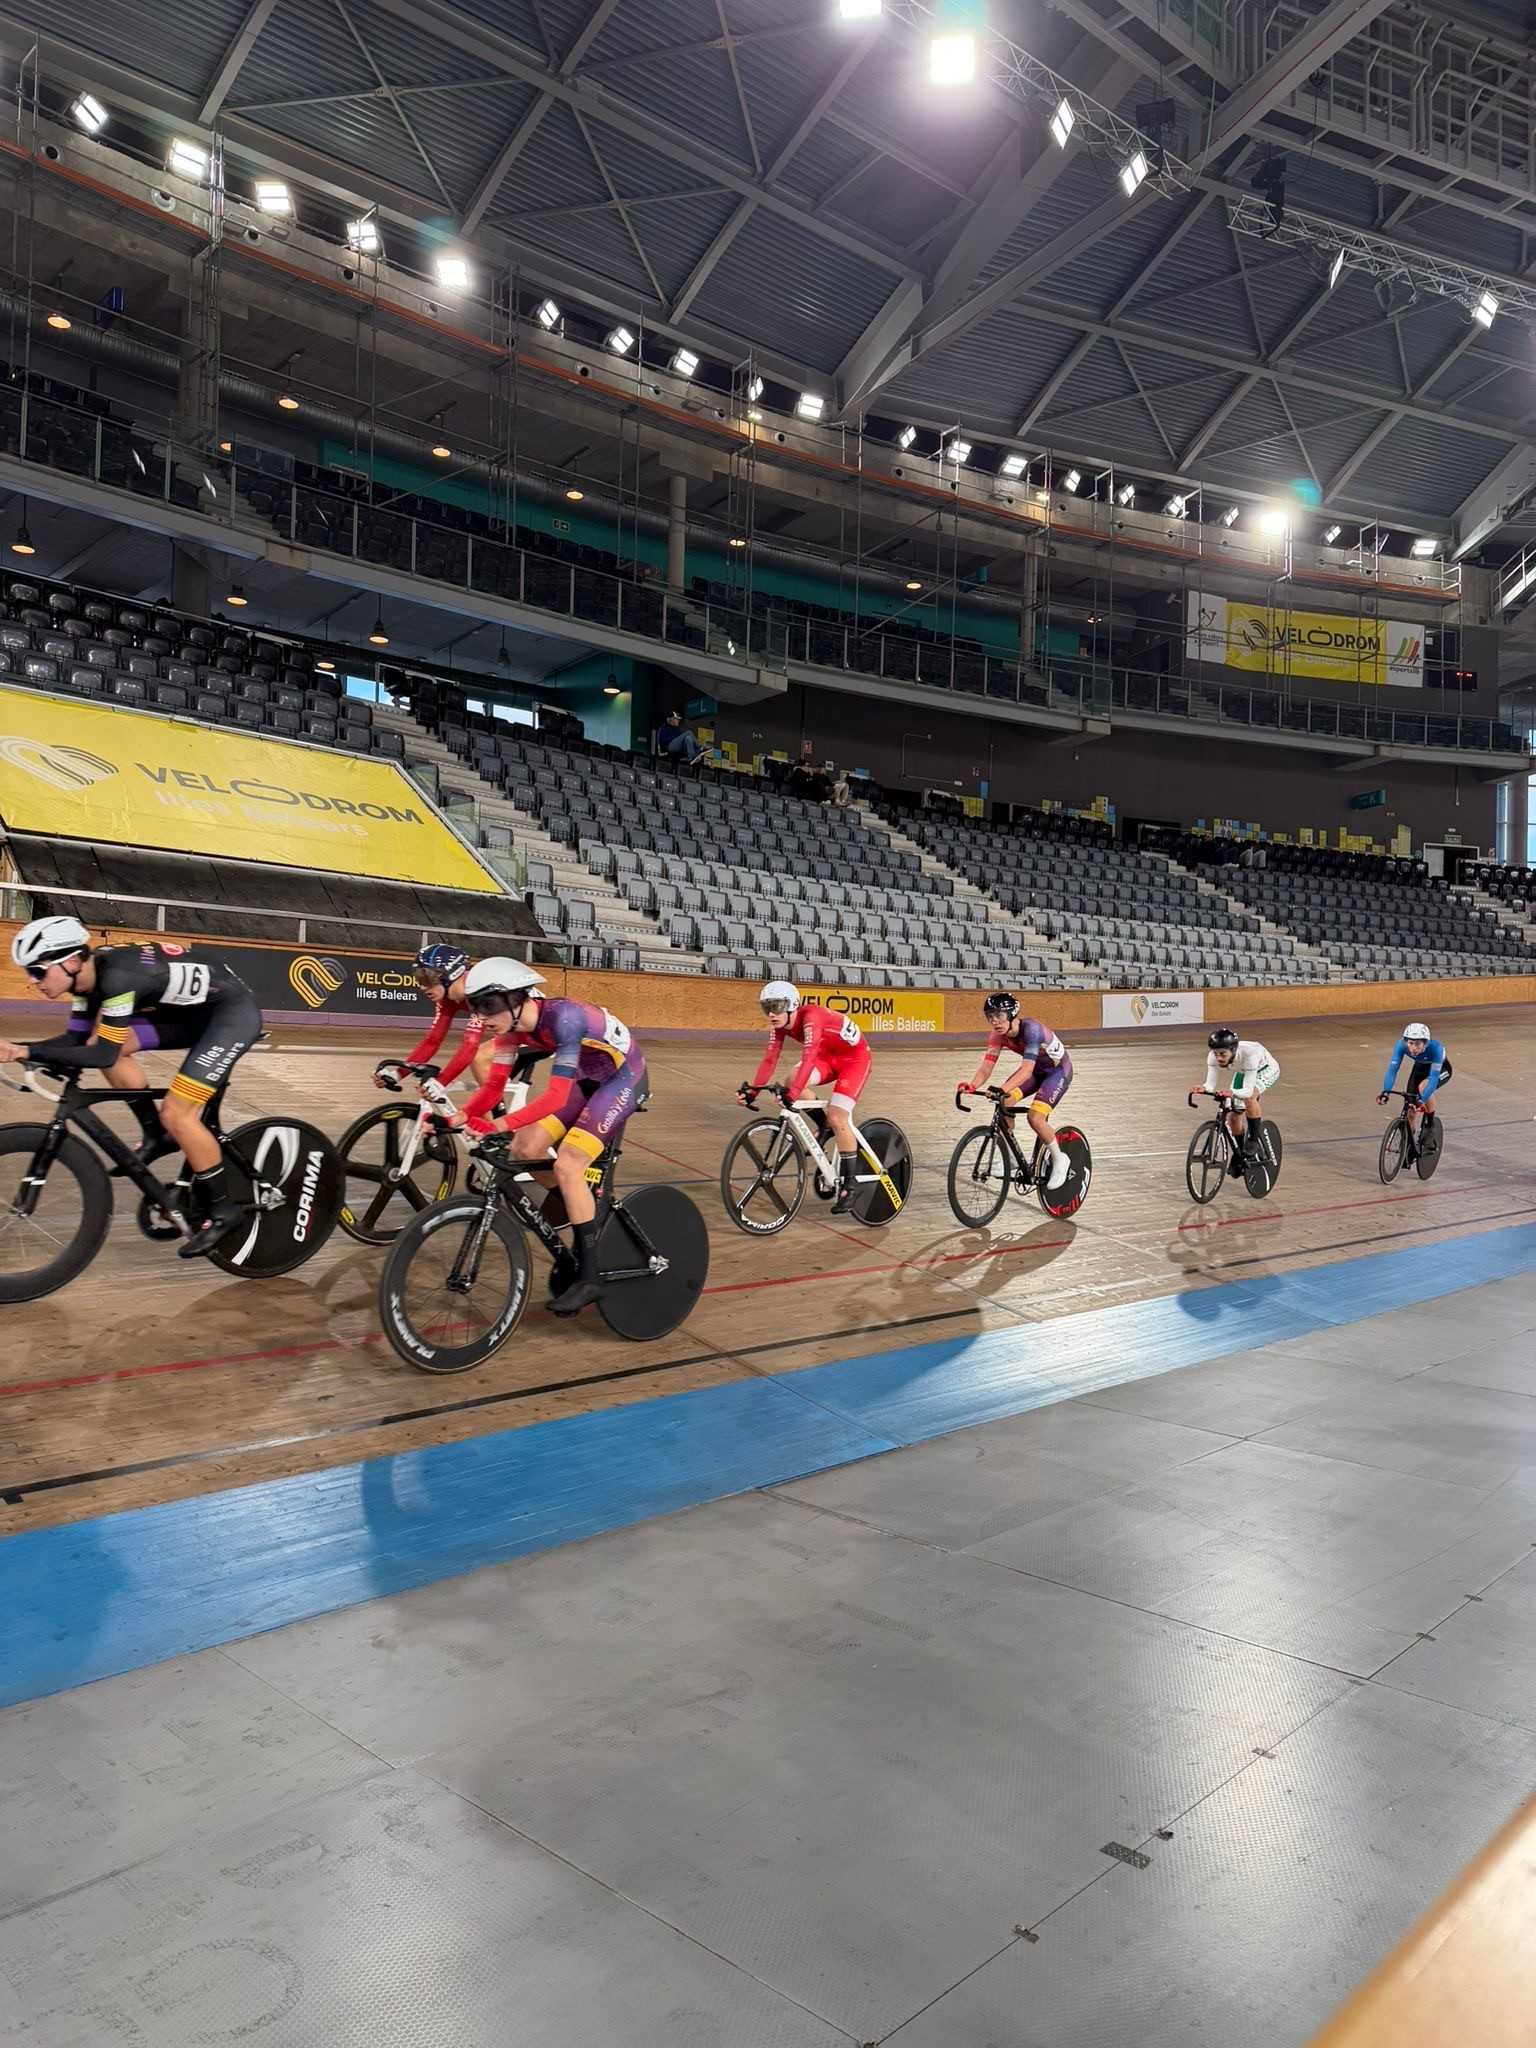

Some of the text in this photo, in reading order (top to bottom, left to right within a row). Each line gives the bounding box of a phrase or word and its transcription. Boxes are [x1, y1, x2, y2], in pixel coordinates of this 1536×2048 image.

[1276, 626, 1380, 651] VELÒDROM
[135, 762, 424, 825] VELÒDROM
[178, 964, 203, 996] 16
[356, 970, 420, 987] VELÒDR
[356, 987, 417, 1001] Illes Balears
[872, 1016, 895, 1031] Illes
[896, 1016, 937, 1032] Balears
[195, 1045, 225, 1068] Illes
[205, 1041, 245, 1082] Balears
[293, 1151, 324, 1242] CORIMA
[741, 1213, 787, 1230] CORIMA
